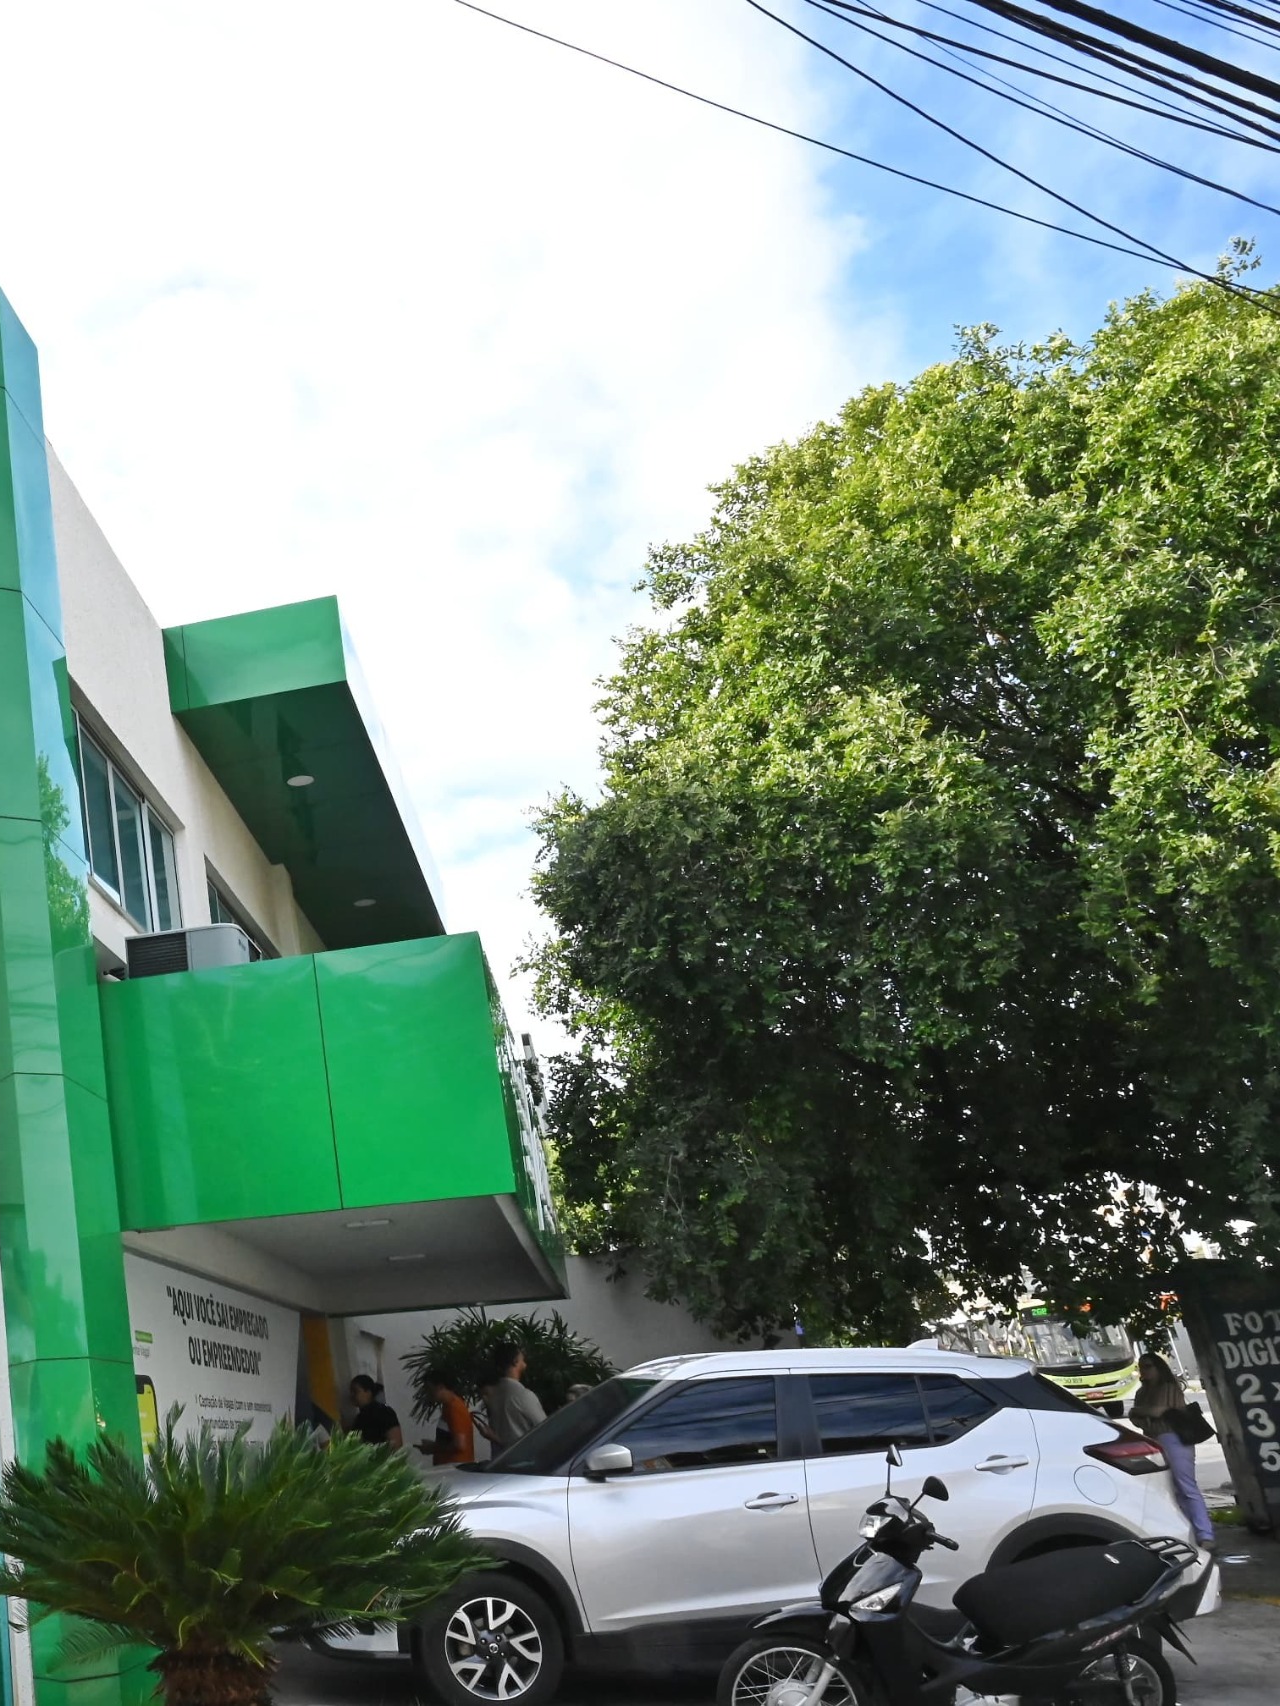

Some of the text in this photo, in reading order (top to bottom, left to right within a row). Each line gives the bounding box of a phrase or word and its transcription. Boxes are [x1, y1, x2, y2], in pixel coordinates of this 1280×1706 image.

[194, 1293, 217, 1326] VOCÊ
[216, 1301, 230, 1330] SAI
[229, 1305, 269, 1341] EMPREGADO
[188, 1336, 202, 1366] OU
[1246, 1408, 1276, 1438] 3
